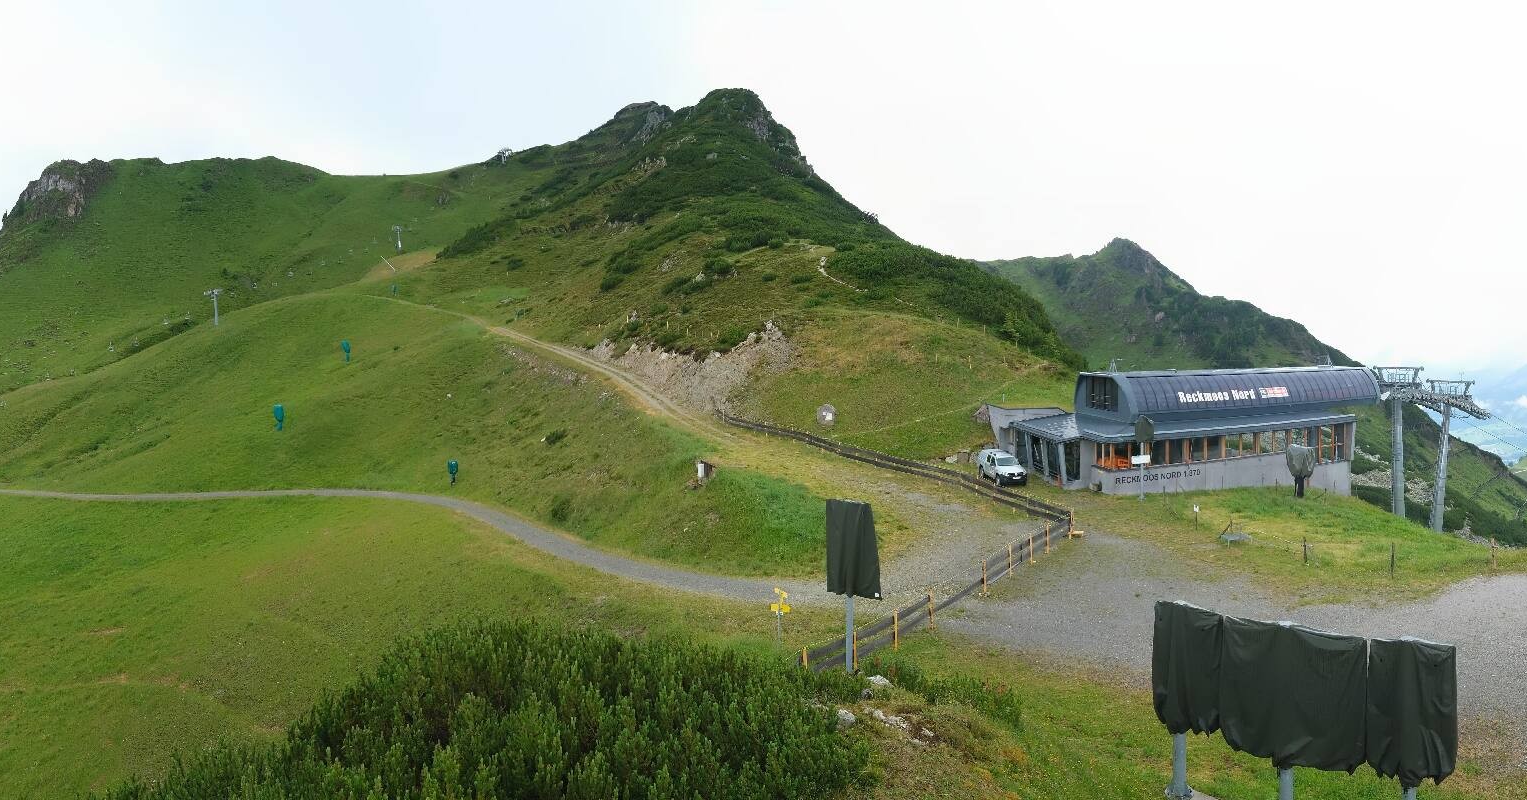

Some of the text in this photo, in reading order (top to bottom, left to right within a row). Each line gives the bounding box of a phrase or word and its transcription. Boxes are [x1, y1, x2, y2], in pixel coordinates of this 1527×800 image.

[1177, 391, 1230, 403] Reckmoos
[1231, 389, 1256, 400] Nord
[1160, 471, 1181, 480] NORD
